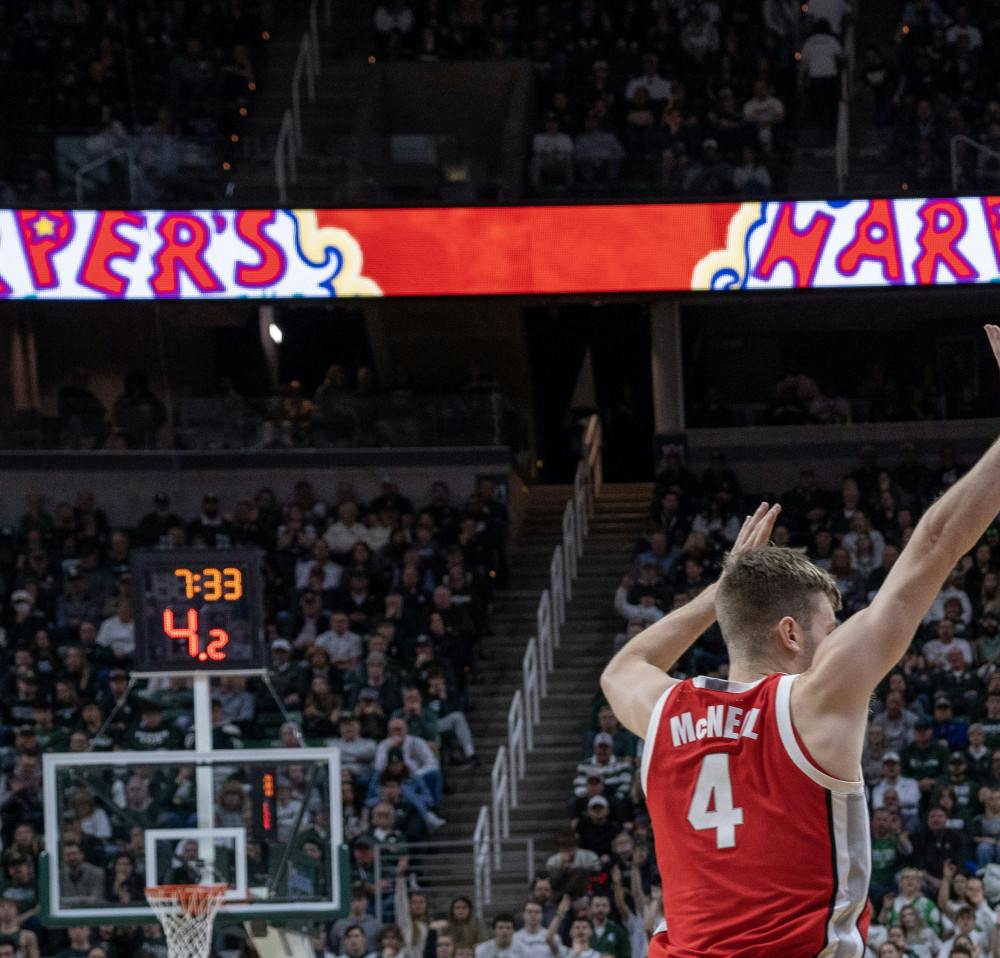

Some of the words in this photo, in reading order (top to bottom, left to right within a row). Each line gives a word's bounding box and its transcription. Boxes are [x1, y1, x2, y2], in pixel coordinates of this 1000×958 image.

[0, 209, 287, 297] PER'S
[174, 567, 243, 601] 7:33
[162, 607, 230, 662] 4.2
[686, 752, 744, 849] 4
